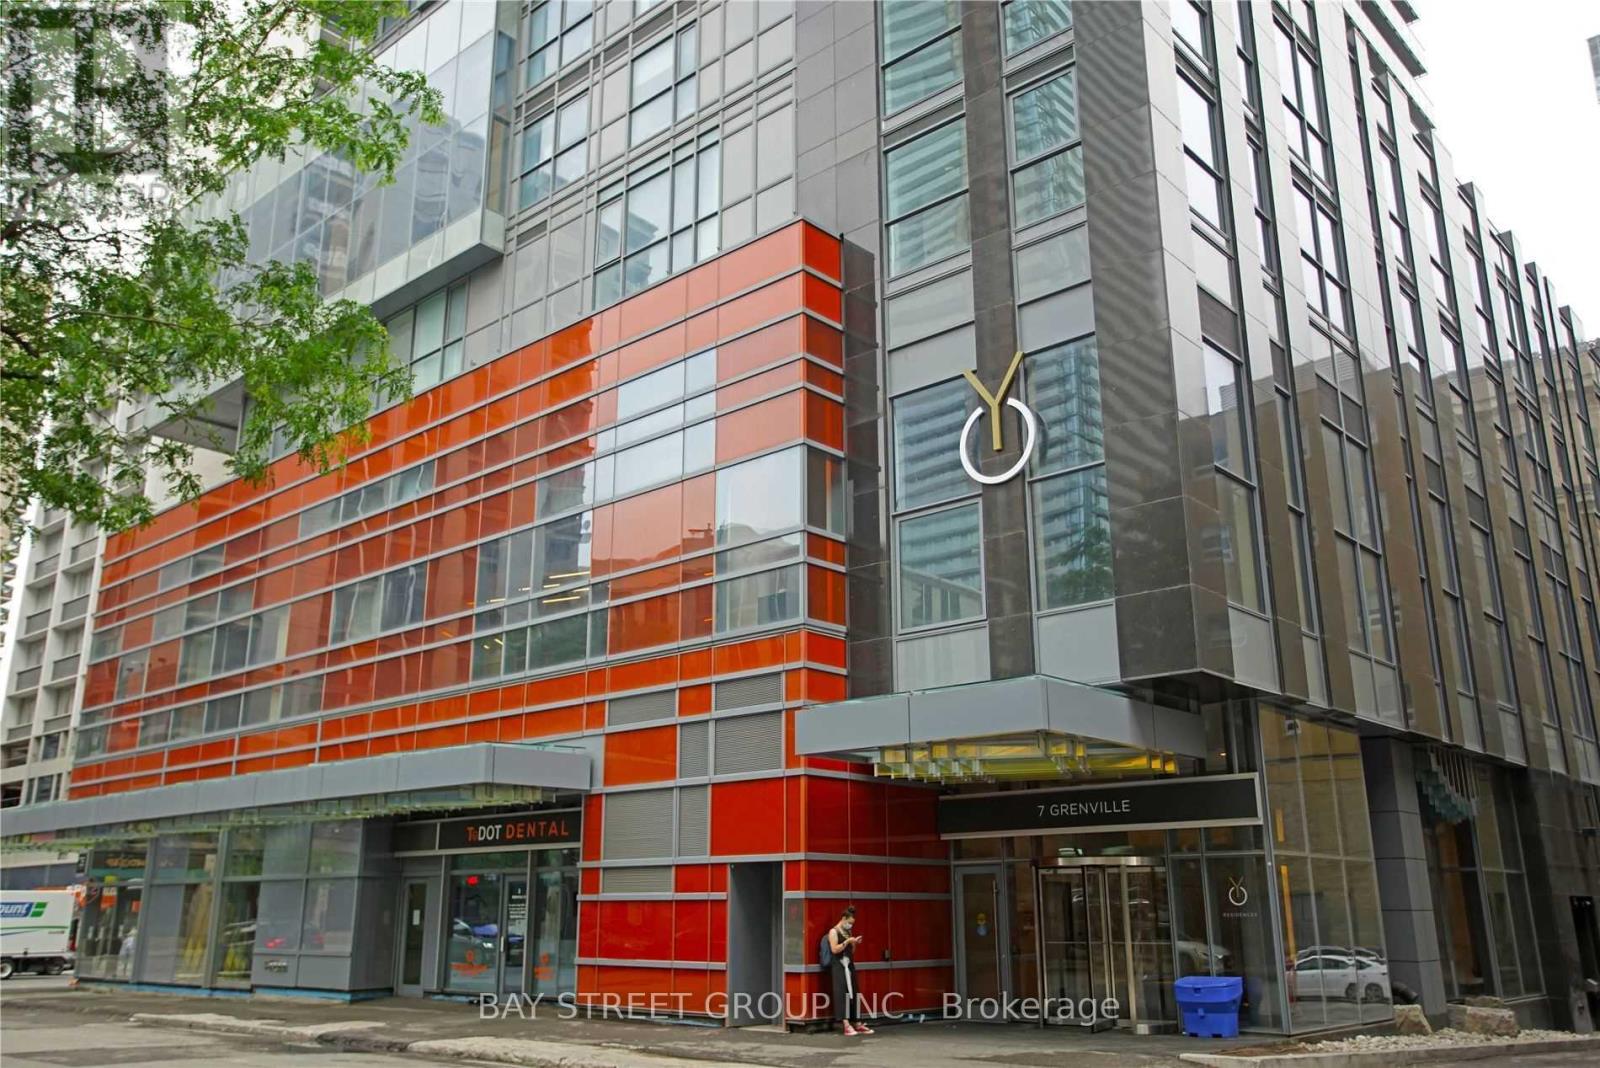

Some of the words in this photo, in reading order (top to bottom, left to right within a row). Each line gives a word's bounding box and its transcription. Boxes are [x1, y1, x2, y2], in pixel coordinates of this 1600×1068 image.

[1037, 805, 1045, 817] 7
[1050, 799, 1131, 816] GRENVILLE
[505, 820, 569, 840] DENTAL
